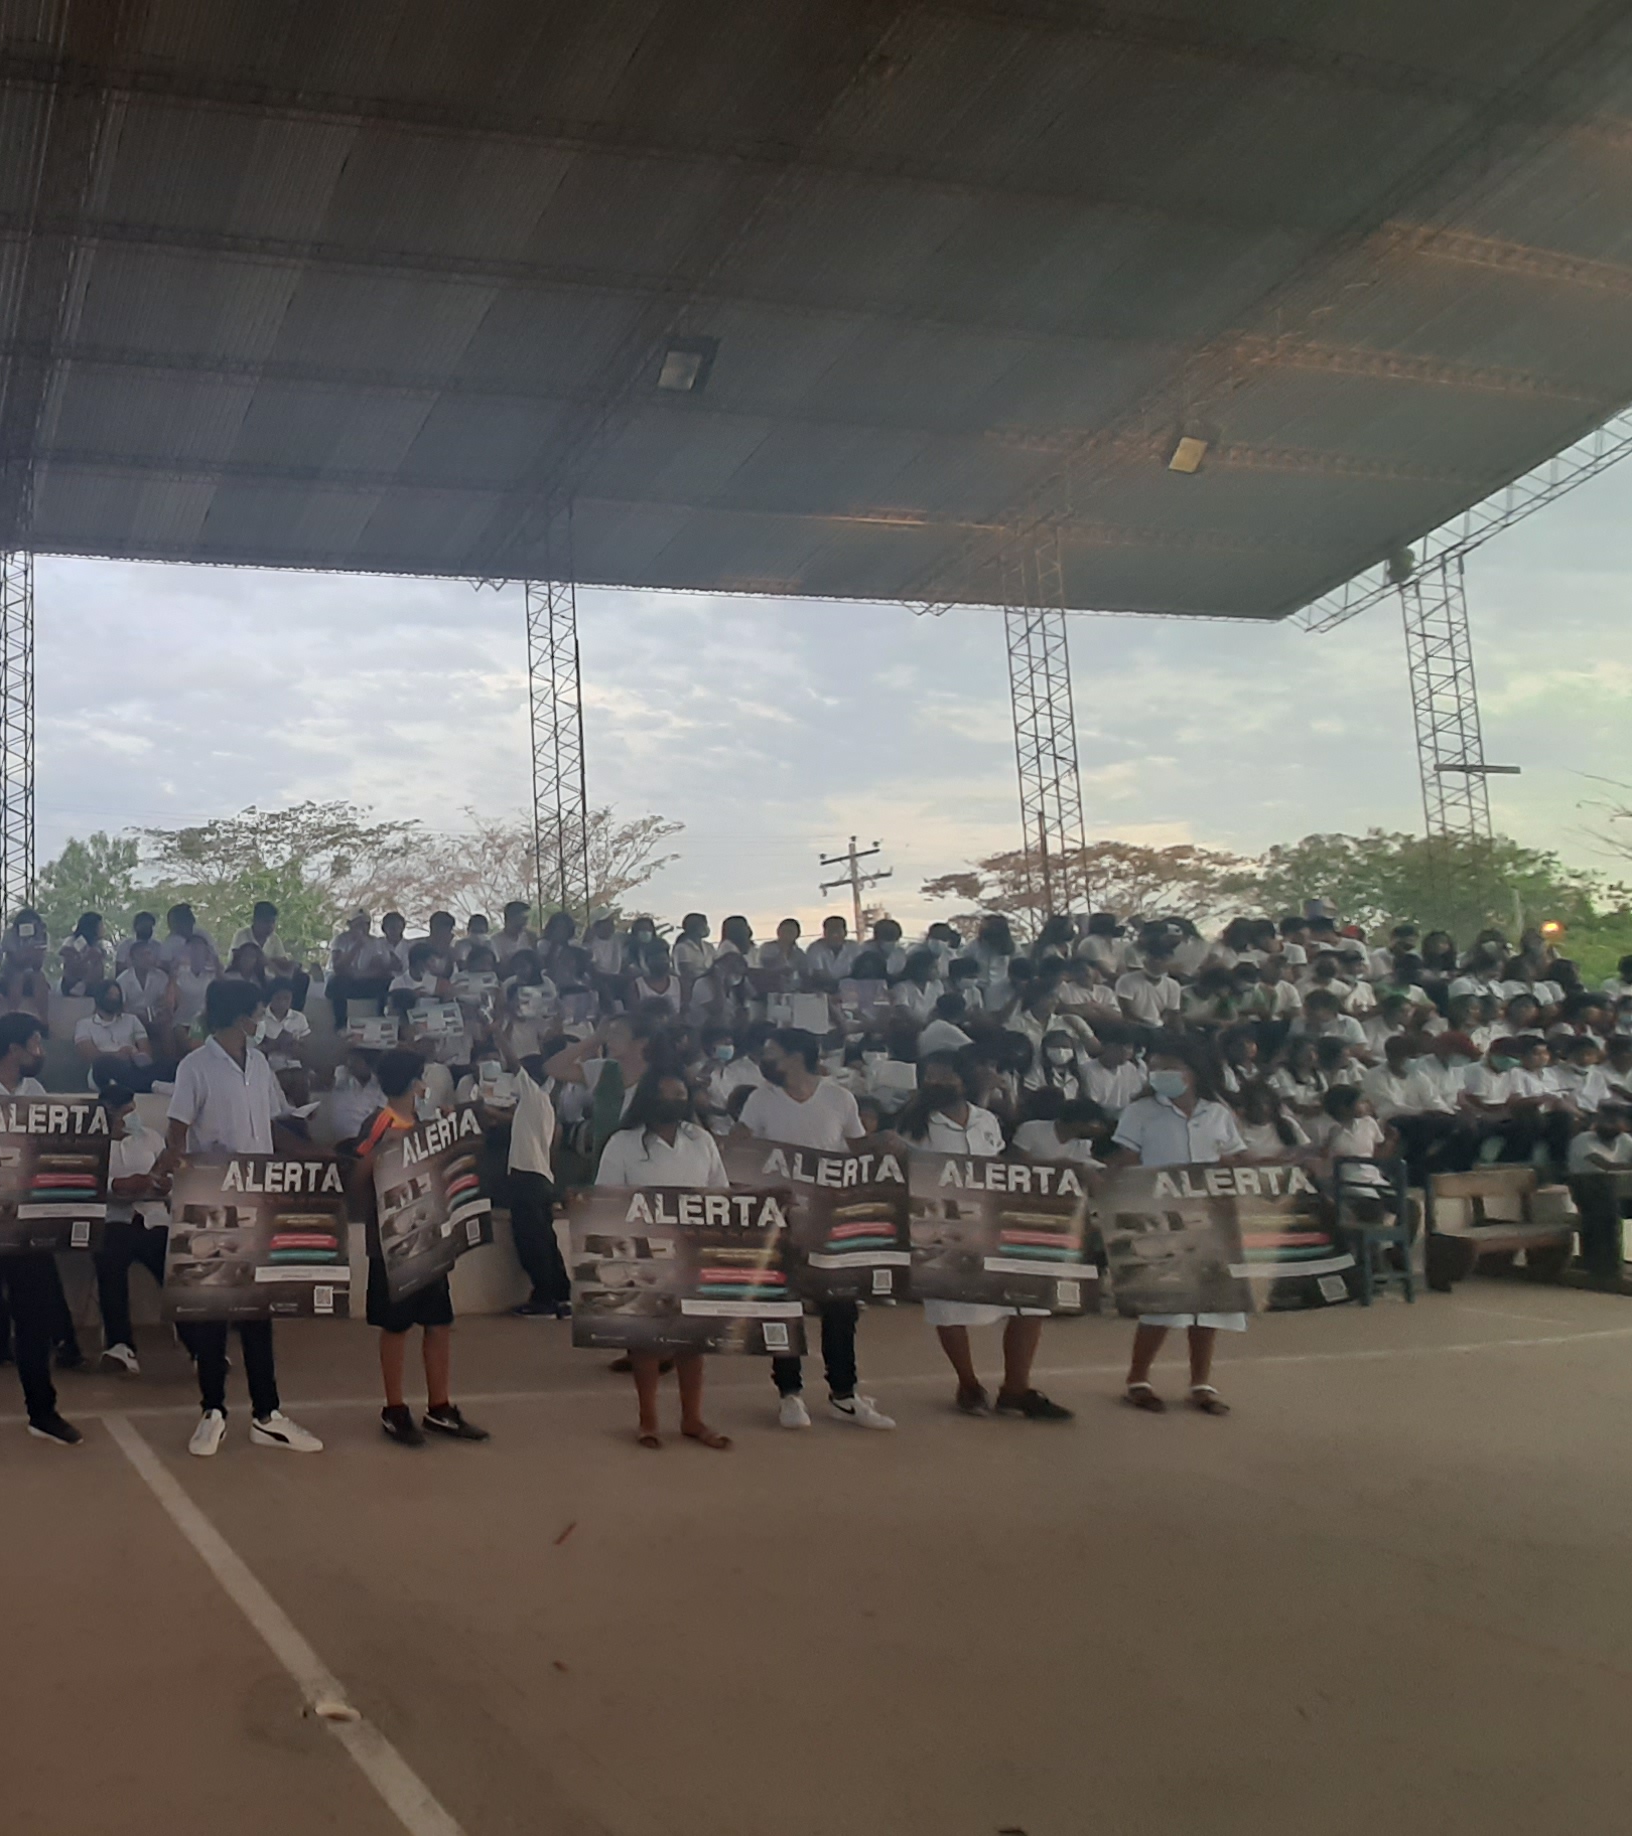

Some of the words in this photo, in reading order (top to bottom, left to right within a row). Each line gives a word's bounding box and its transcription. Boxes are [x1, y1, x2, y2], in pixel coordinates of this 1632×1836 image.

[402, 1108, 482, 1168] ALERTA
[221, 1160, 344, 1194] ALERTA
[762, 1148, 905, 1188] ALERTA
[938, 1160, 1083, 1197] ALERTA
[1153, 1167, 1317, 1199] ALERTA
[625, 1193, 786, 1228] ALERTA
